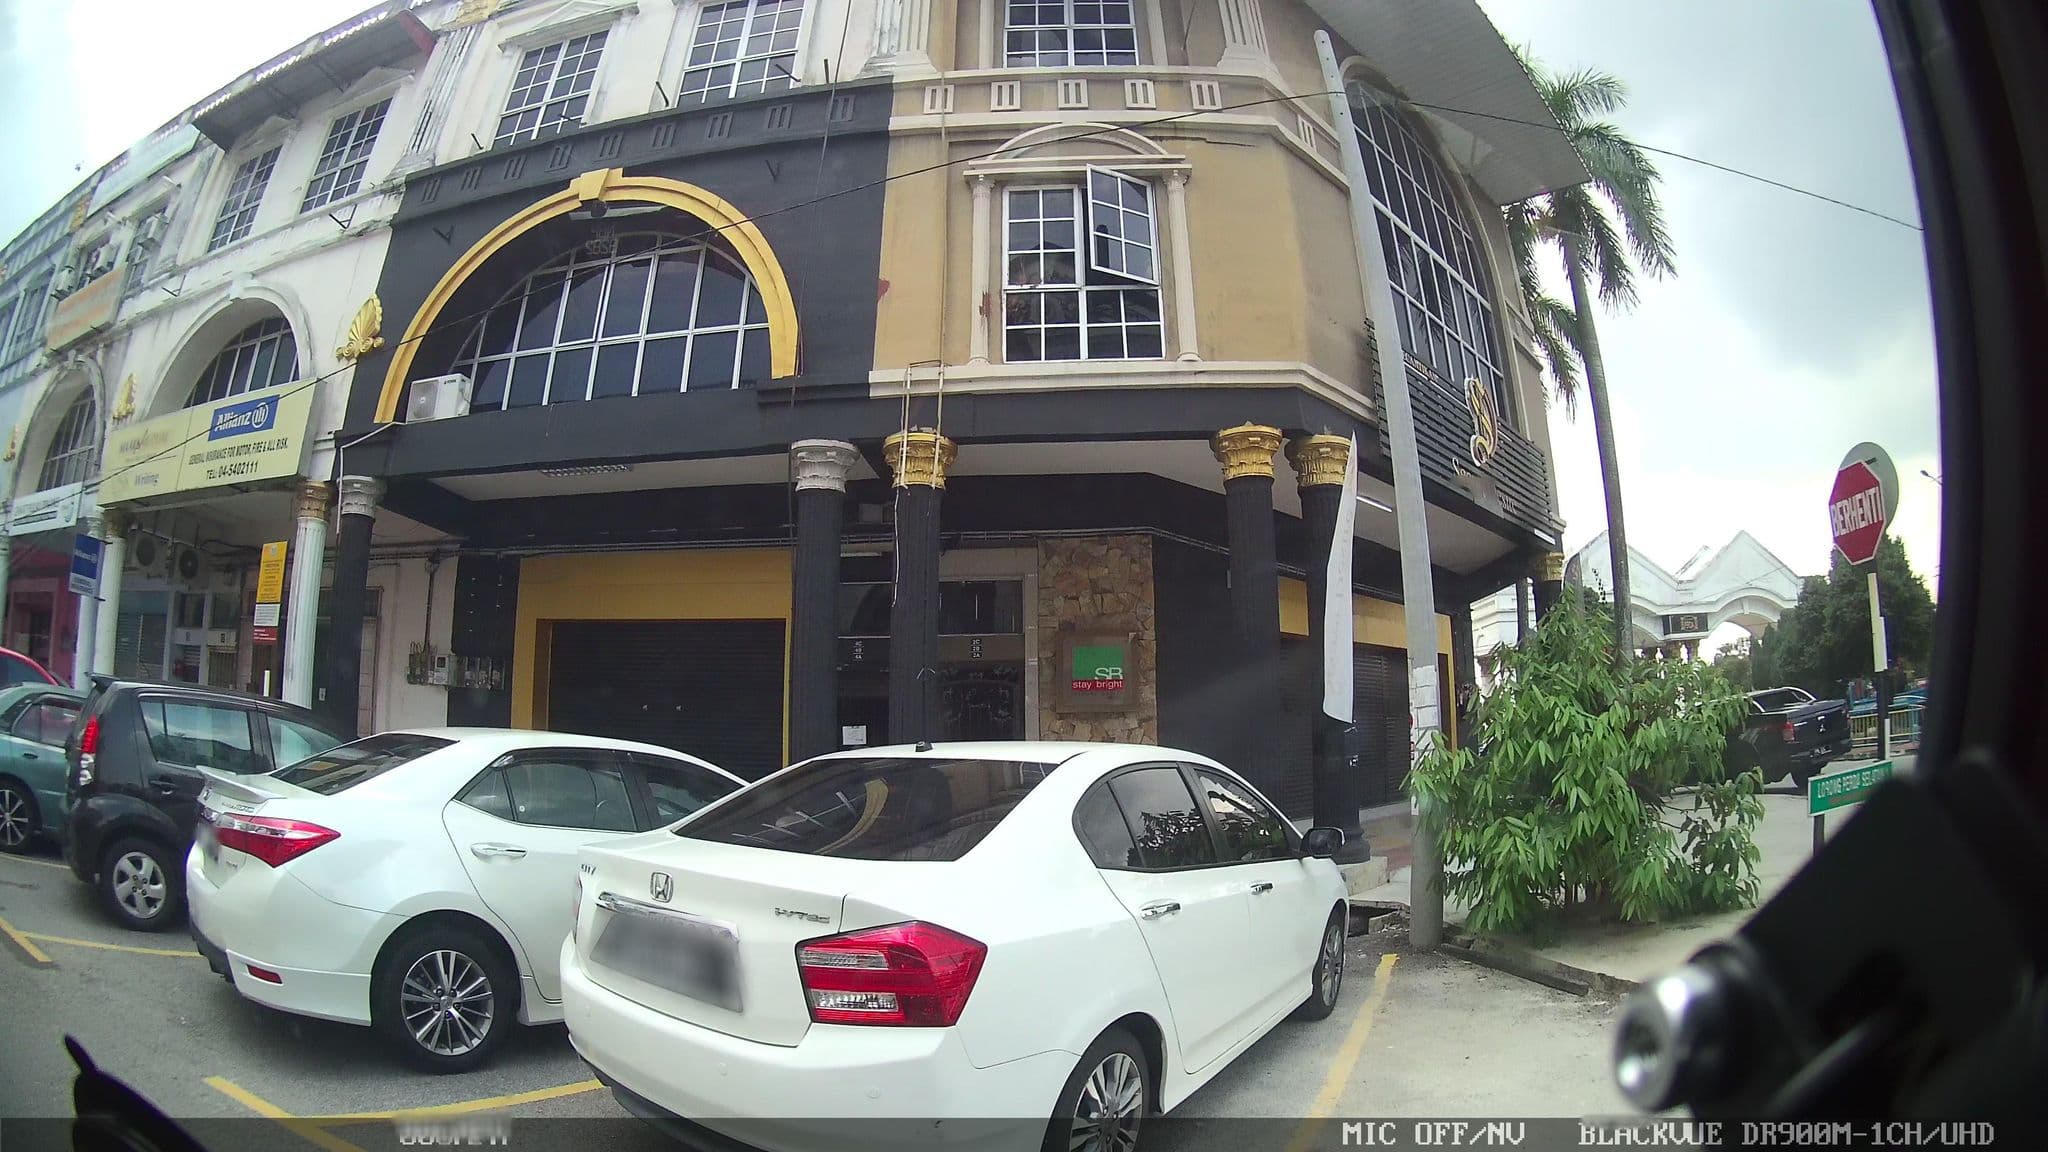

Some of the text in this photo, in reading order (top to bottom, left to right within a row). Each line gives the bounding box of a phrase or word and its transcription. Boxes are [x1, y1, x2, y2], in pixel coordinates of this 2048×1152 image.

[214, 409, 252, 432] Allianz
[218, 459, 259, 478] 04-5402111
[1830, 486, 1883, 538] BERHENTI
[1072, 680, 1123, 690] stay bright
